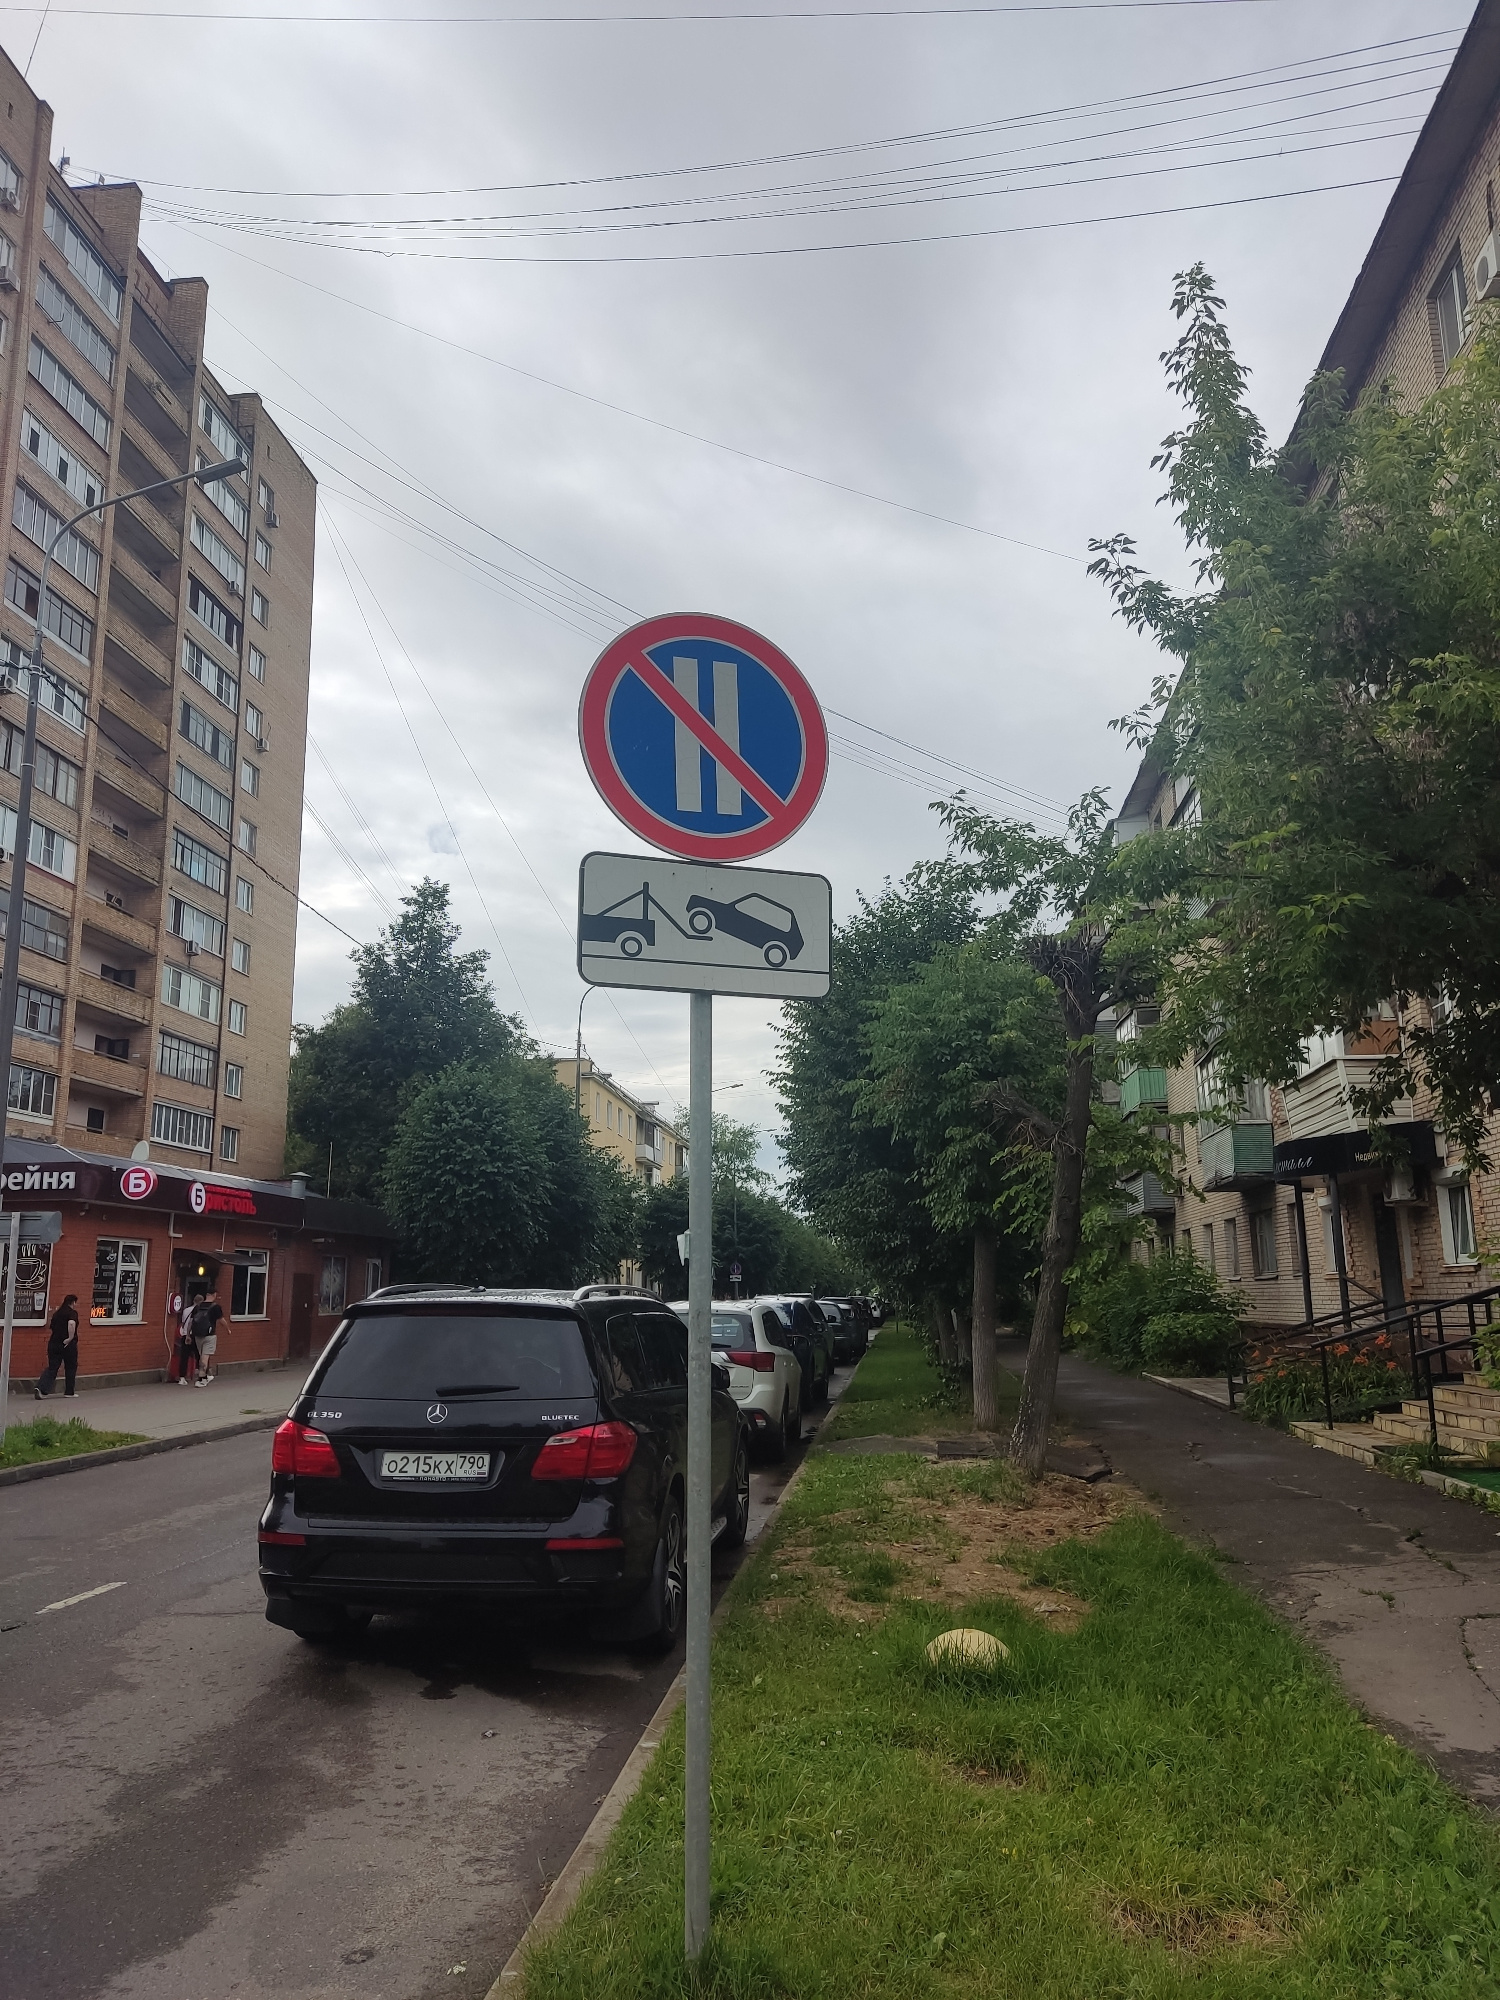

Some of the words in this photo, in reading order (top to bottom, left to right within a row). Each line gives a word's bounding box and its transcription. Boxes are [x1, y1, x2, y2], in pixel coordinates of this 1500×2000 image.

[129, 1172, 147, 1193] Б
[320, 1411, 343, 1419] 350
[459, 1455, 485, 1470] 790
